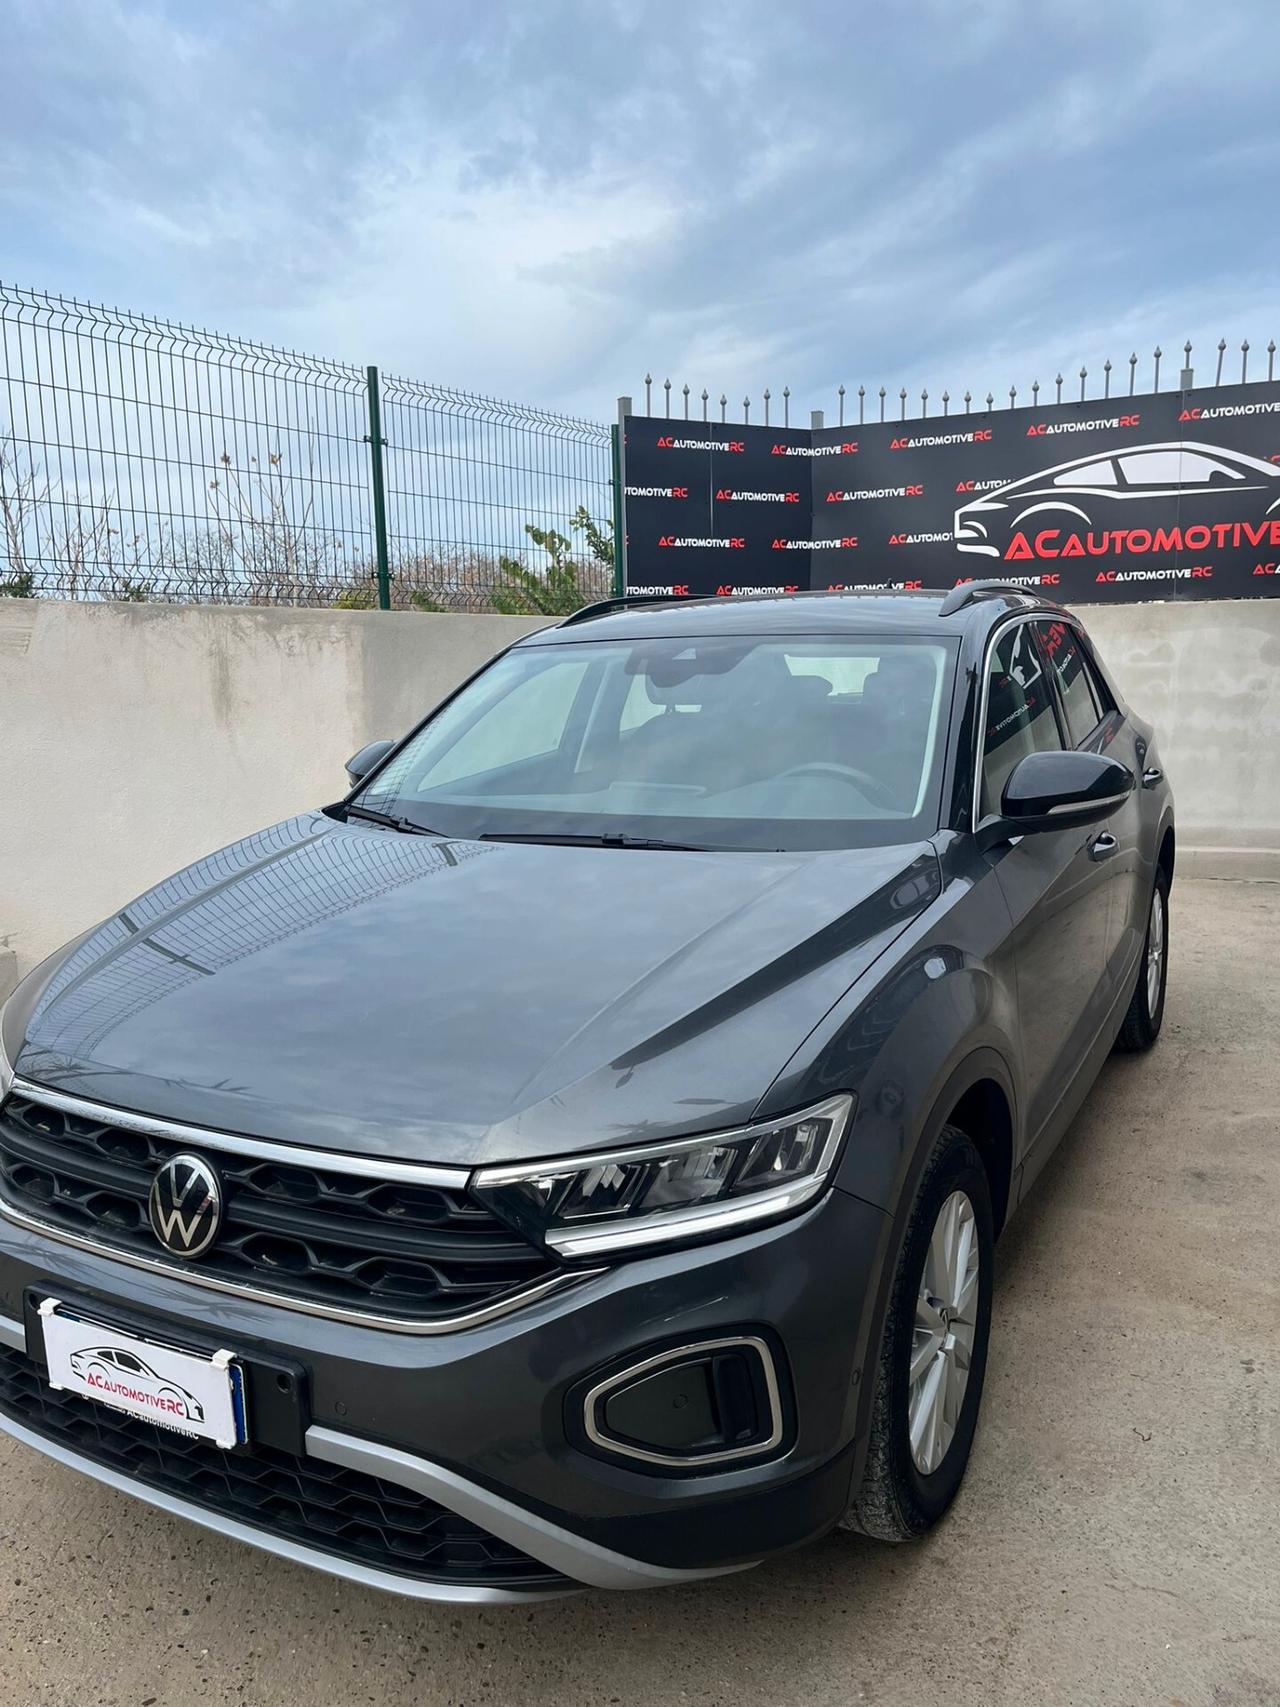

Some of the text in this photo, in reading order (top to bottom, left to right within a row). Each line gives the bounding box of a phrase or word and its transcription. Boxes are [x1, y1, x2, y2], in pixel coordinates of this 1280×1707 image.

[1026, 414, 1140, 437] ACAUTOMOTIVERC
[657, 437, 744, 452] ACAUTOMOTIVERC
[890, 429, 992, 449] ACAUTOMOTIVERC
[771, 442, 858, 457] ACAUTOMOTIVERC
[716, 490, 800, 502] ACAUTOMOTIVERC
[826, 484, 923, 502] ACAUTOMOTIVERC
[658, 536, 745, 548] ACAUTOMOTIVERC
[772, 537, 858, 550] ACAUTOMOTIVERC
[1095, 566, 1213, 582] ACAUTOMOTIVERC
[153, 1157, 214, 1248] VW
[87, 1372, 185, 1417] ACAUTOMOTIVERC
